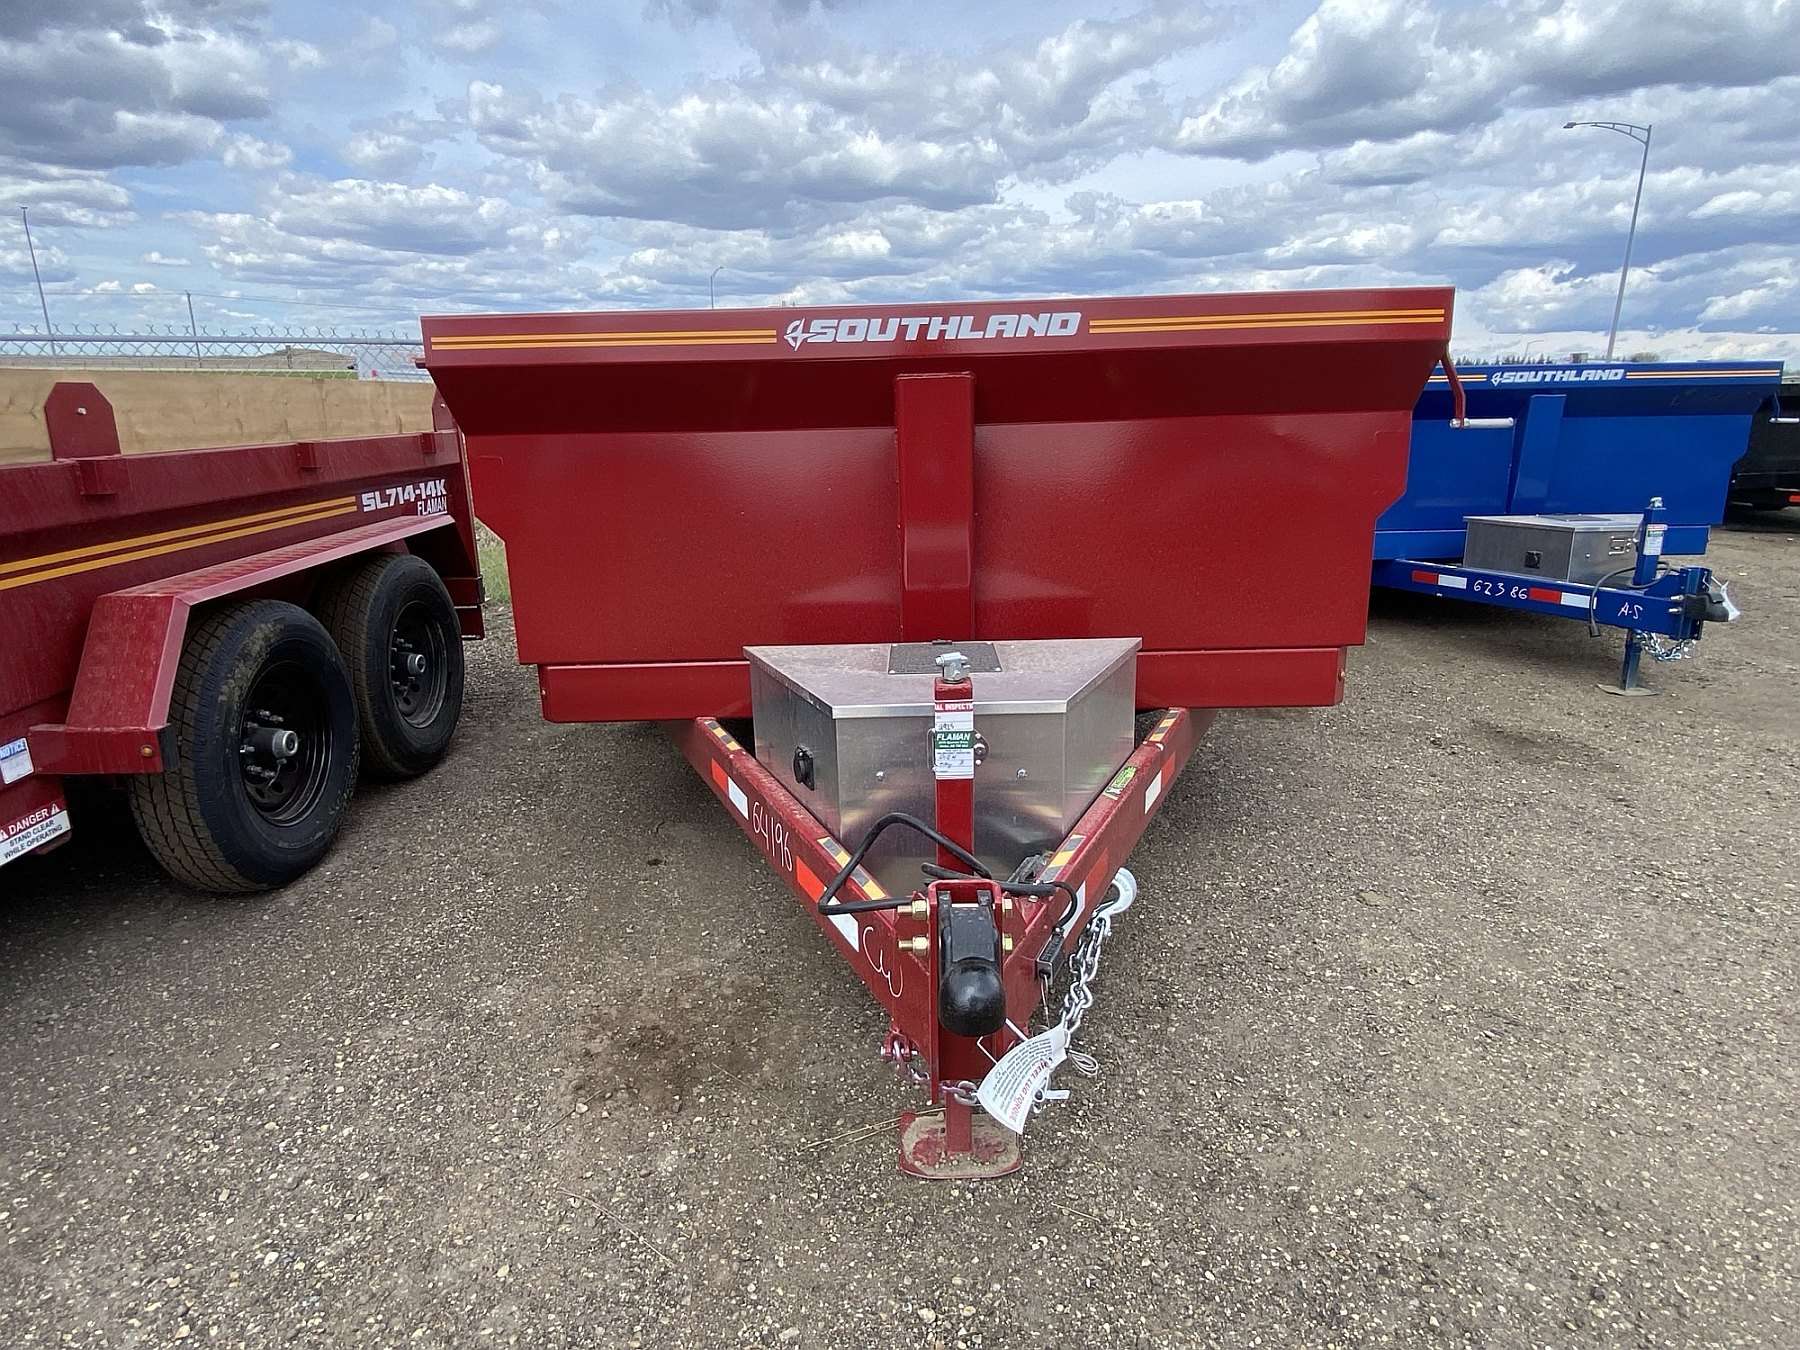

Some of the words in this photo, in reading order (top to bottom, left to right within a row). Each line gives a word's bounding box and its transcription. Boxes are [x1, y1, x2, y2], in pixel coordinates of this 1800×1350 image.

[807, 312, 1081, 343] SOUTHLAND
[1501, 369, 1625, 383] SOUTHLAND
[361, 479, 447, 512] SL714-14K
[417, 496, 447, 516] FLAMAN
[8, 808, 49, 835] DANGER
[9, 831, 32, 847] STAND
[32, 820, 55, 834] CLEAR
[4, 844, 26, 859] WHILE
[26, 824, 63, 847] OPERATING
[753, 801, 793, 872] 64196
